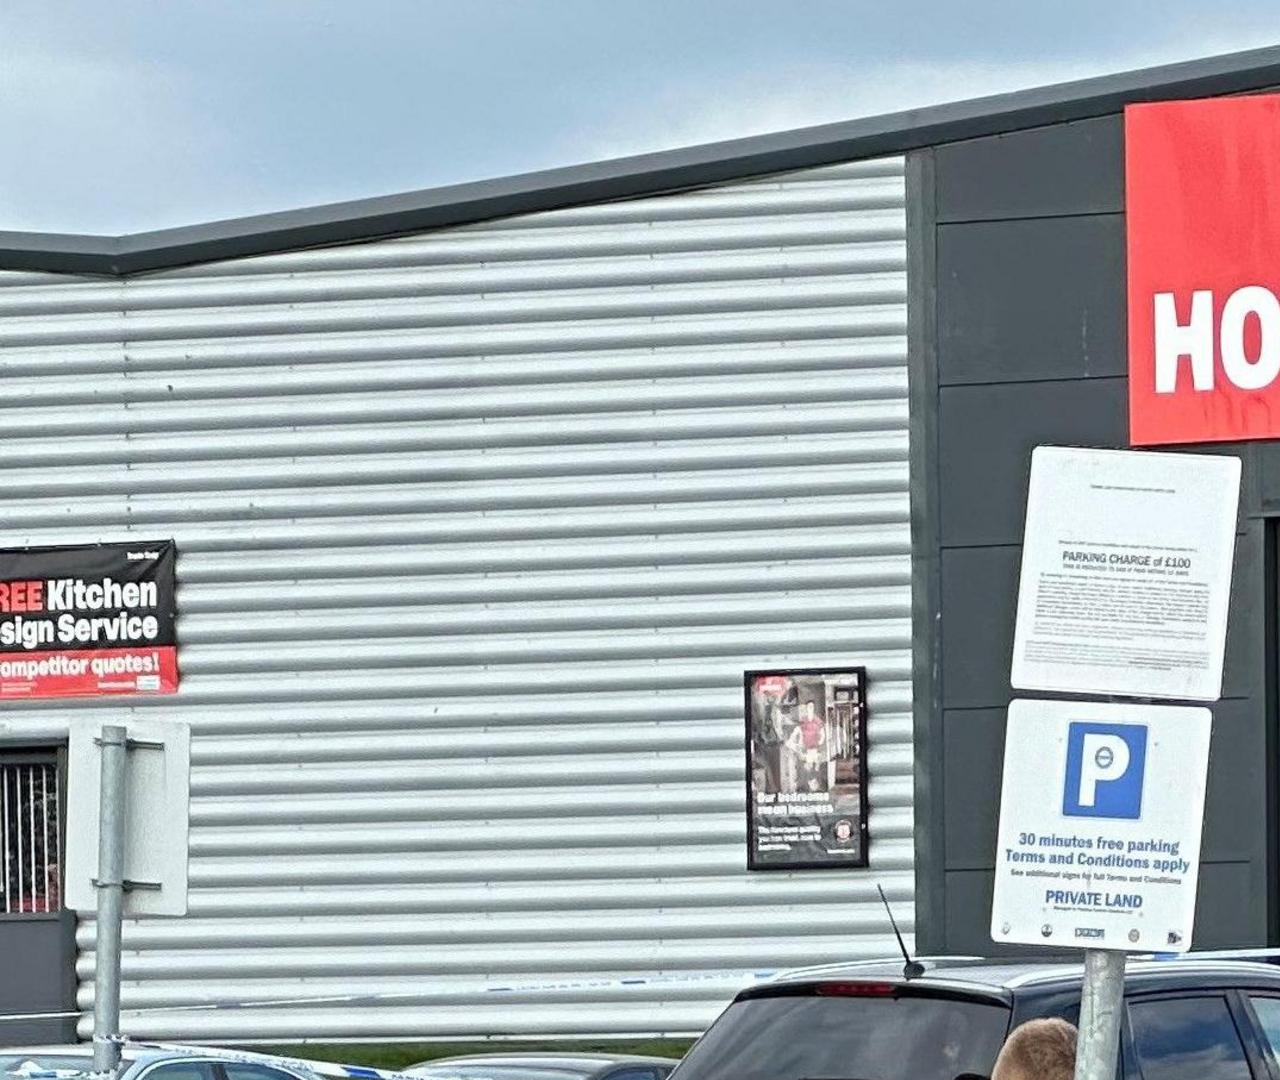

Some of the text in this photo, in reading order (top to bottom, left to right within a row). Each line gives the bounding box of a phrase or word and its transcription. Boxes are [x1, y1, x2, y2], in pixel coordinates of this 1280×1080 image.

[1062, 551, 1106, 563] PARKING
[1109, 554, 1151, 566] CHARGE
[1165, 557, 1191, 568] £100
[48, 577, 157, 610] Kitchen
[57, 611, 158, 642] Service
[91, 652, 160, 677] quotes!
[1078, 733, 1130, 806] P
[1019, 833, 1180, 856] 30 minutes free parking
[1006, 849, 1190, 874] Terms and Conditions apply
[1046, 890, 1143, 908] PRIVATE LAND
